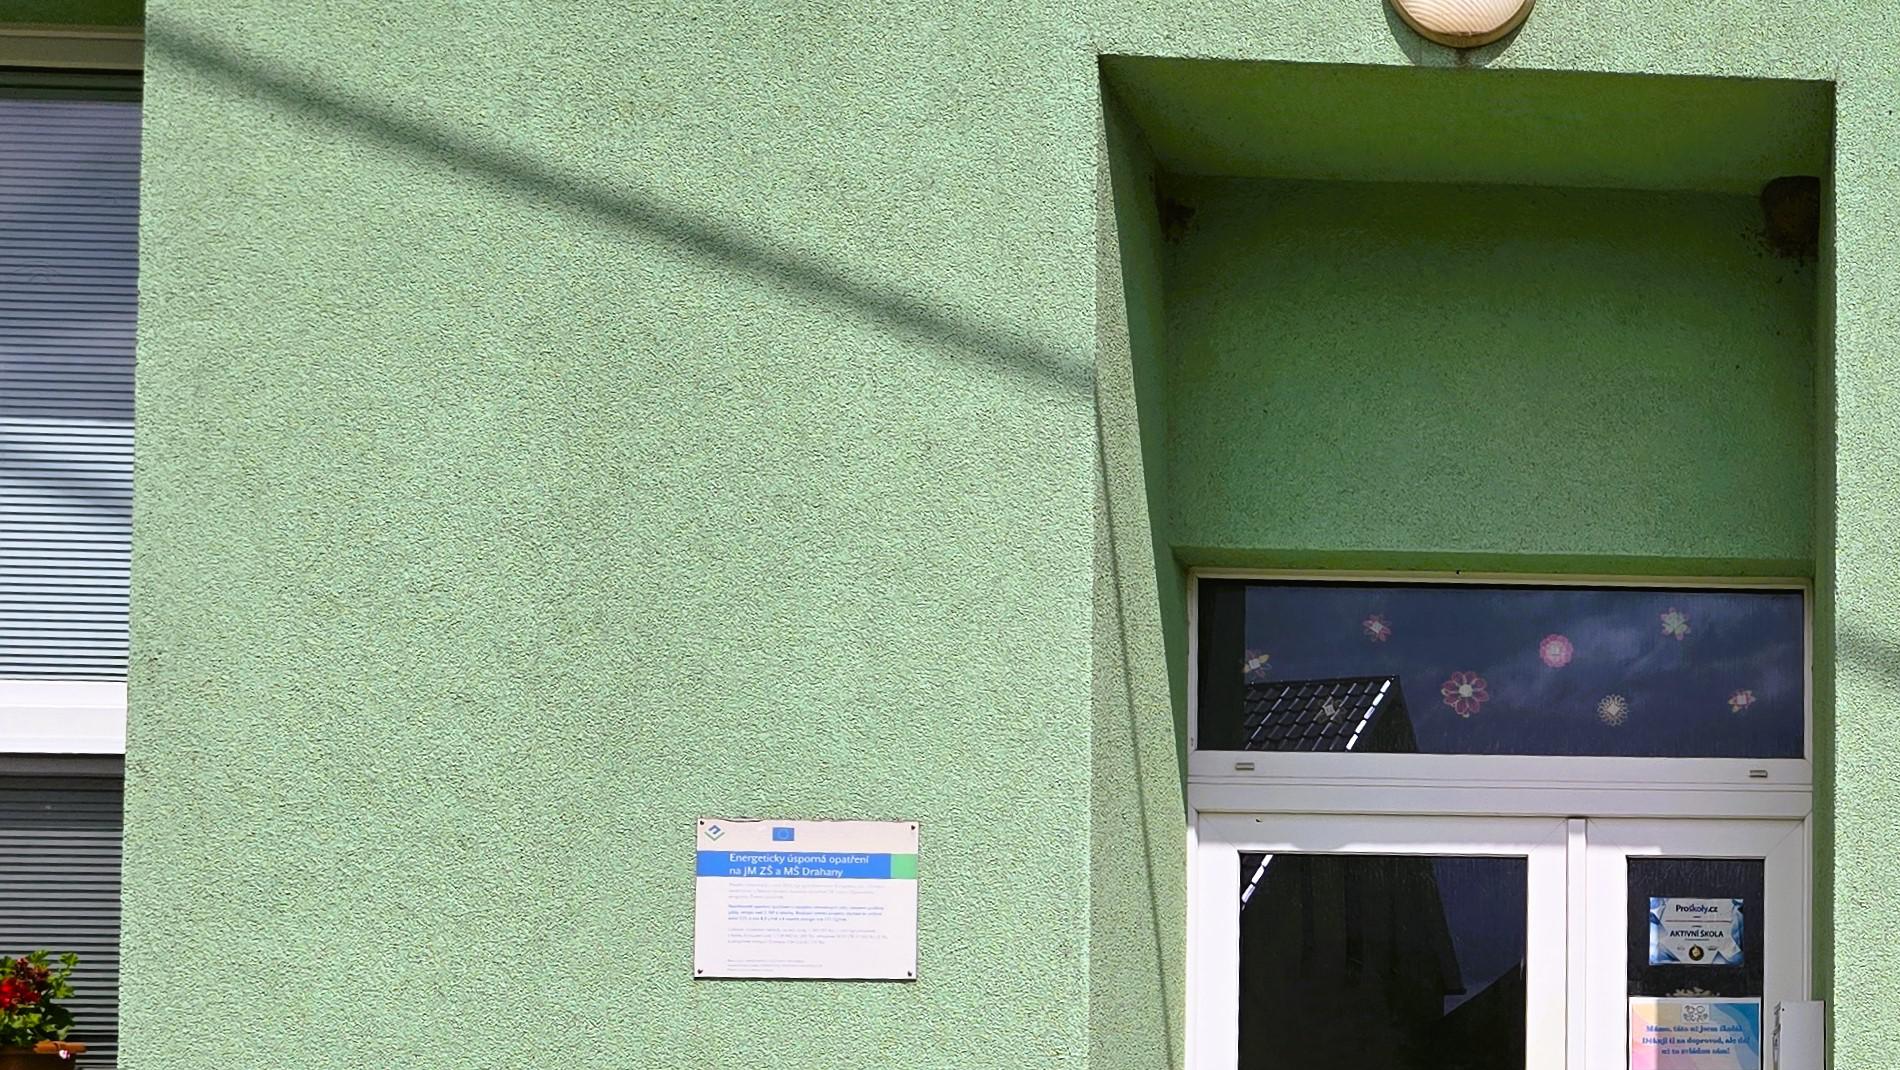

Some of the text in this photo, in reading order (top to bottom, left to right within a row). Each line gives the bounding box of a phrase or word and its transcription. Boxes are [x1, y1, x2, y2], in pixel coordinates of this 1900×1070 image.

[729, 853, 869, 865] Energeticky úsporná opatření
[729, 867, 741, 875] na
[743, 866, 757, 876] JM
[759, 865, 773, 875] ZŠ
[783, 866, 799, 876] MŠ
[802, 867, 844, 878] Drahany
[1675, 904, 1718, 914] Proškoly.cz
[1670, 930, 1724, 938] AKTIVNÍ ŠKOLA
